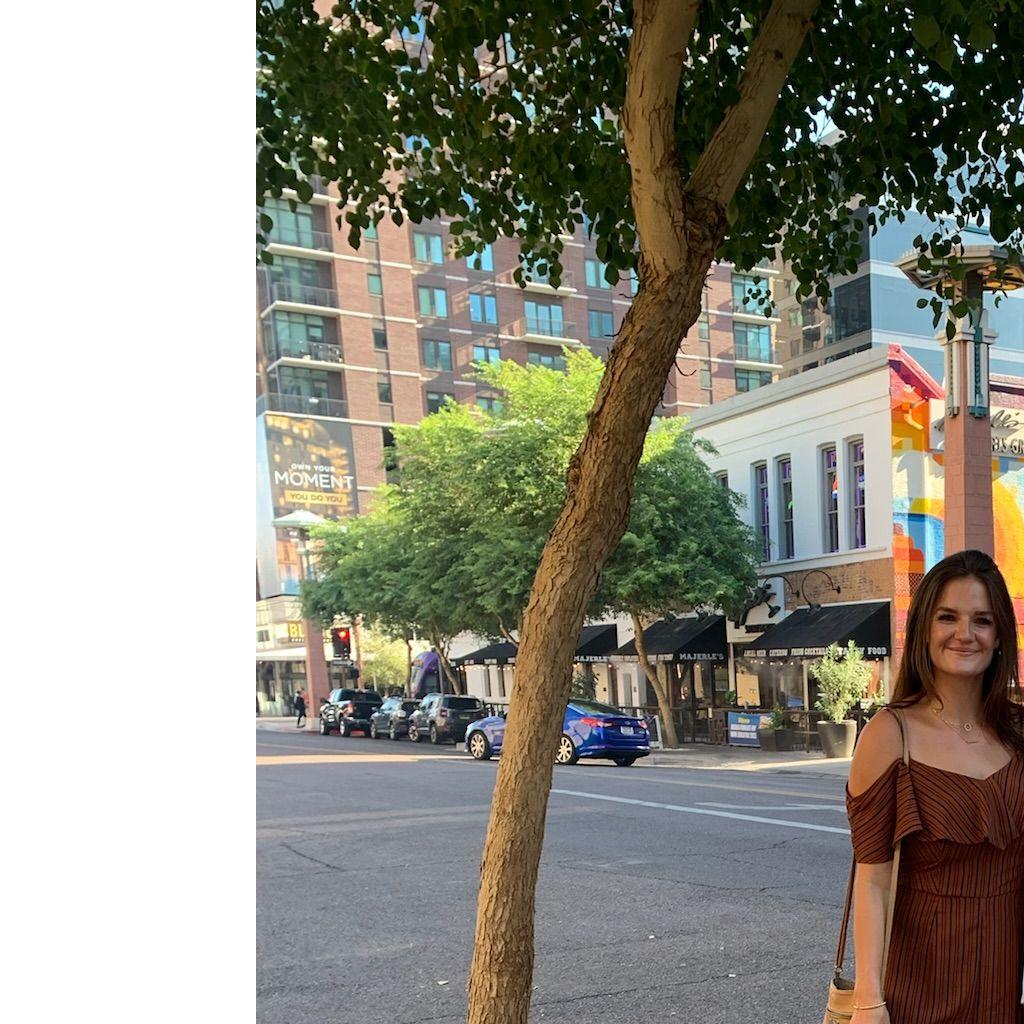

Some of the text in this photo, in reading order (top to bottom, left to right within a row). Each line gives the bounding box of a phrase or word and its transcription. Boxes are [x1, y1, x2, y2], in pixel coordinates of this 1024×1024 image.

[290, 463, 336, 473] OWN YOUR
[274, 470, 354, 490] MOMENT
[290, 493, 309, 501] YOU
[310, 494, 324, 502] DO
[867, 646, 887, 655] FOOD
[679, 653, 724, 661] MAJERLE'S
